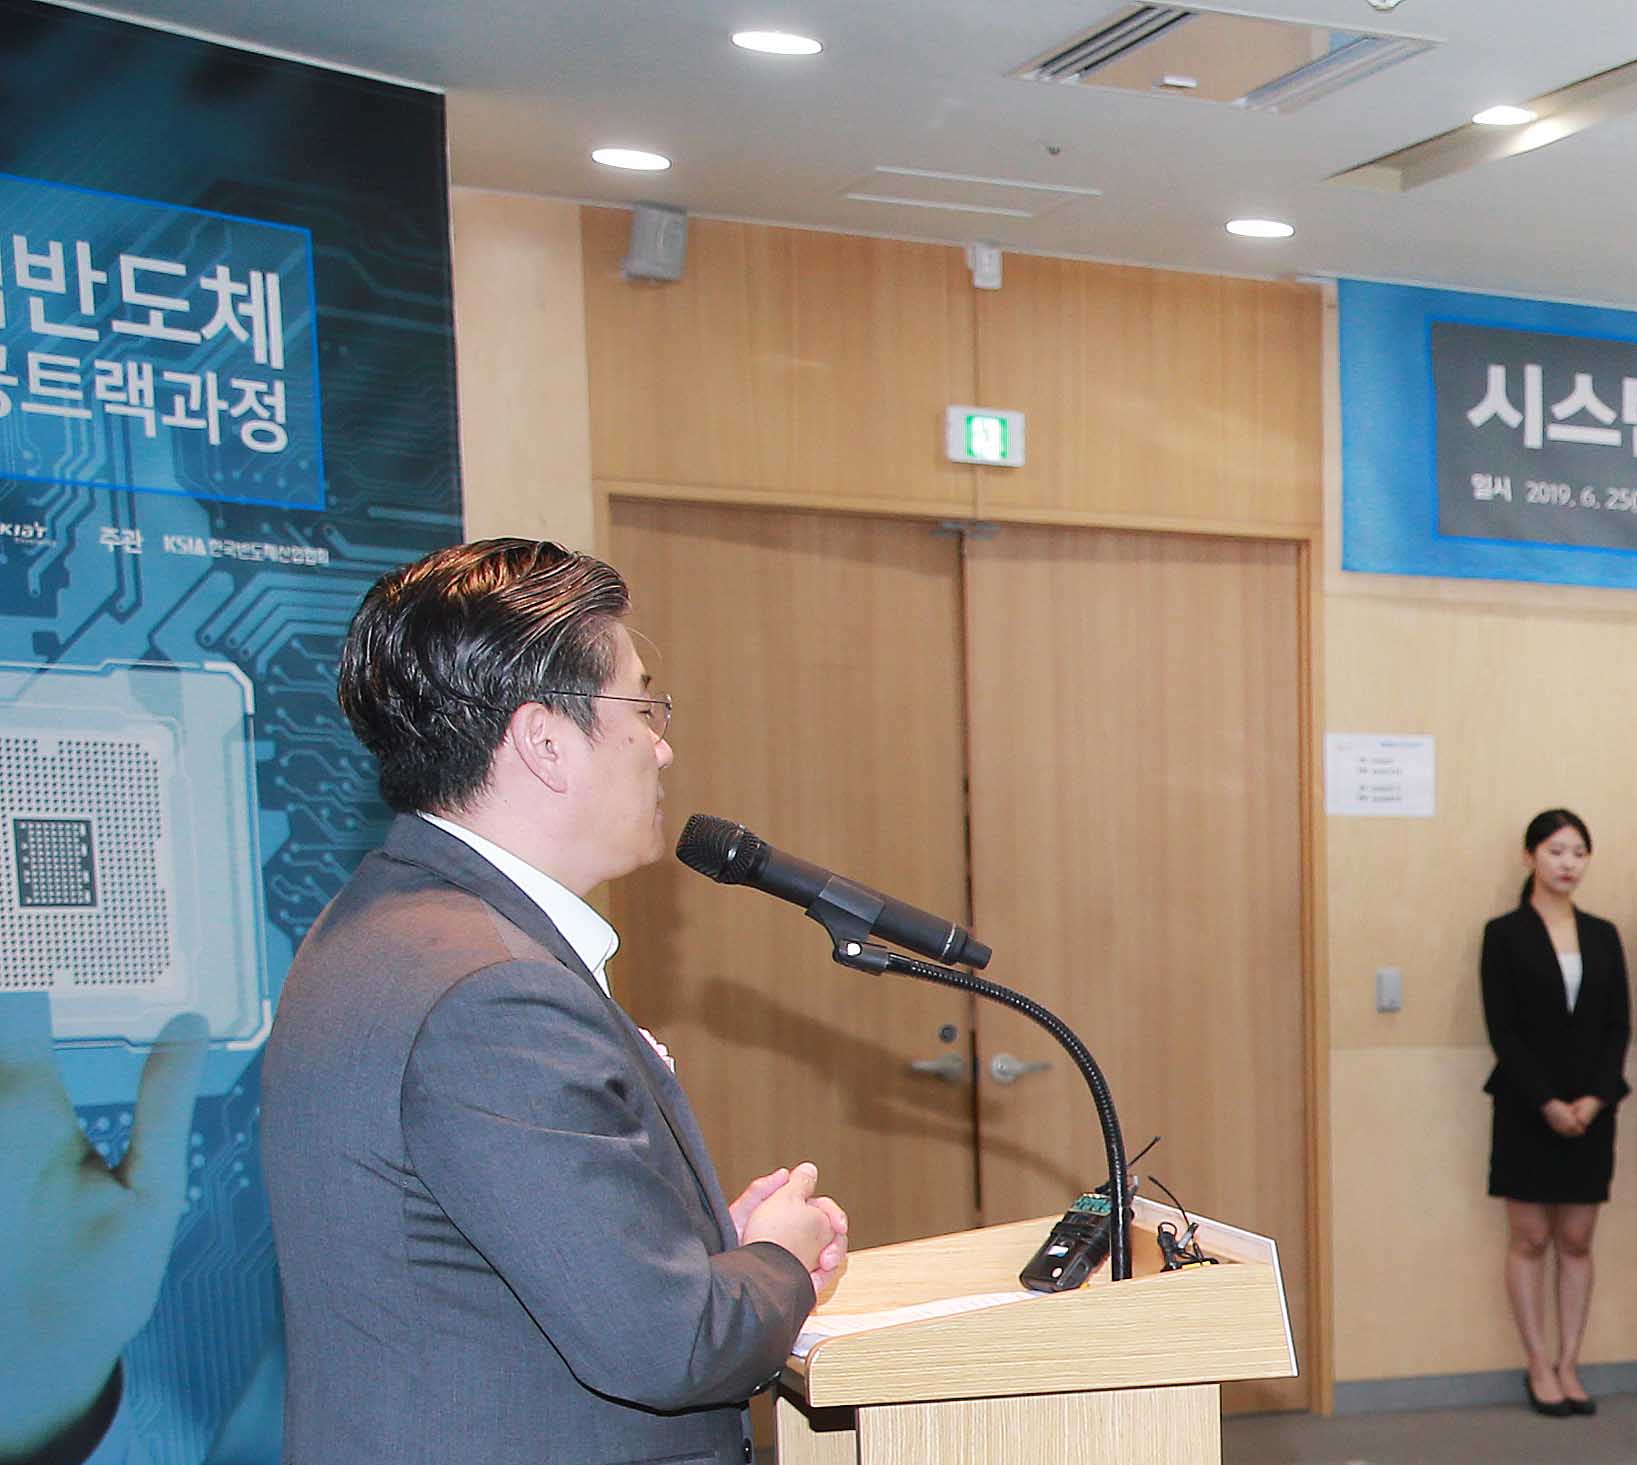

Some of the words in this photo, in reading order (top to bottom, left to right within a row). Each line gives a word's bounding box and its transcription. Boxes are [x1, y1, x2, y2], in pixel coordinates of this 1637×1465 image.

[0, 234, 285, 370] 반도체
[1470, 472, 1512, 502] 일시
[99, 525, 144, 555] 주관
[161, 533, 207, 557] KSIA
